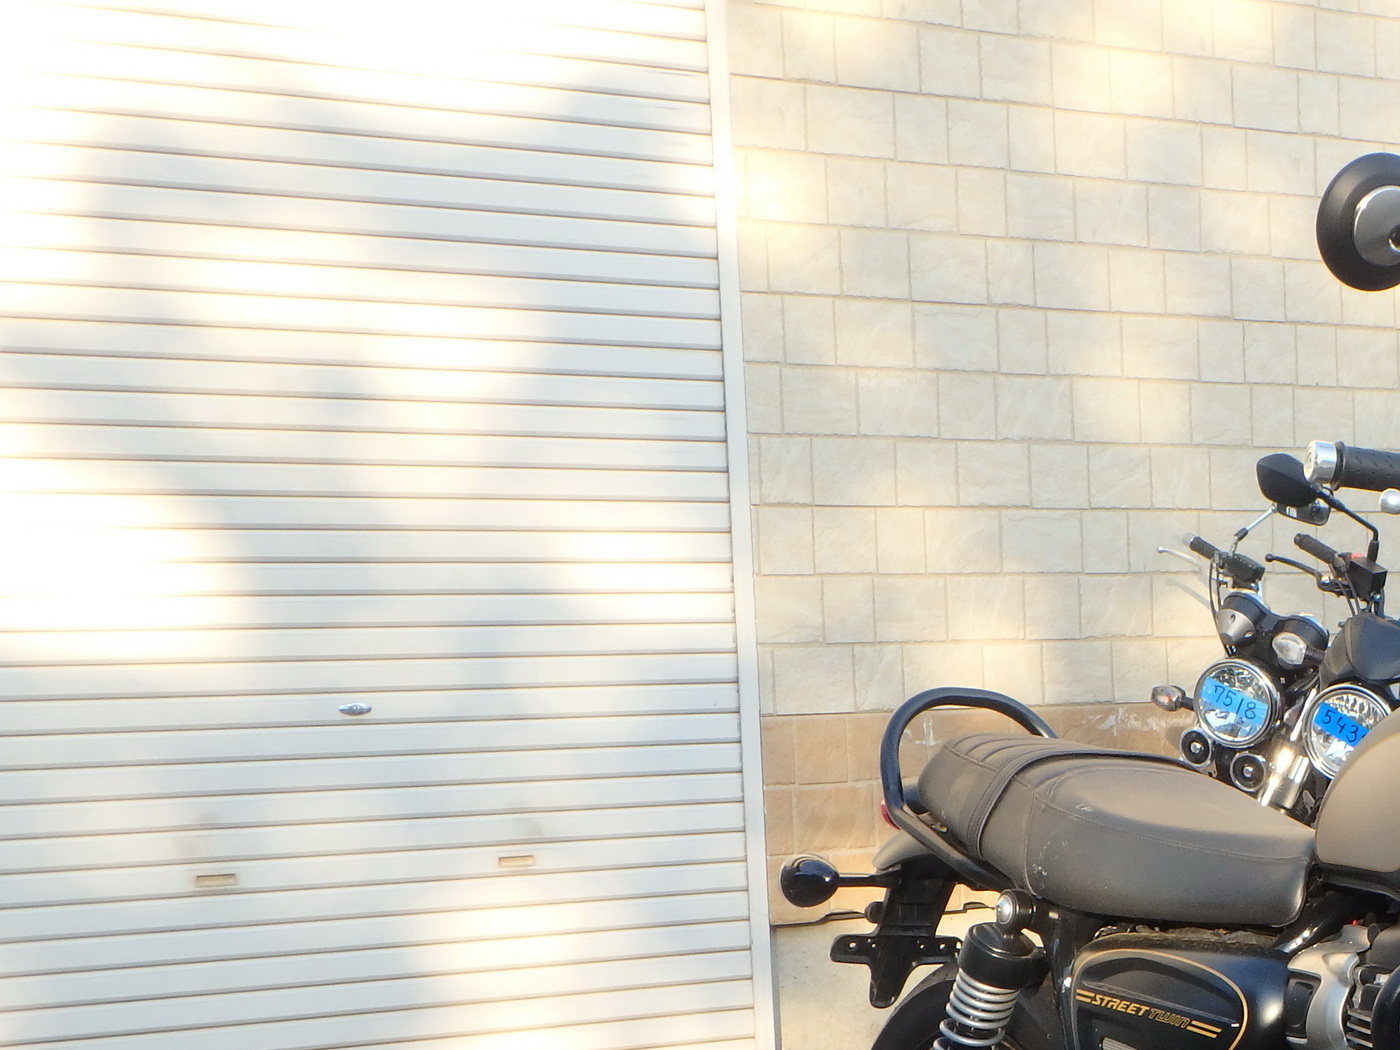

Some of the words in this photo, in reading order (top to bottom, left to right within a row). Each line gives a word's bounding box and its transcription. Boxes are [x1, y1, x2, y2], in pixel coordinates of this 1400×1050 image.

[1214, 684, 1257, 720] 7518
[1321, 708, 1367, 744] 543
[1091, 994, 1150, 1016] STREET
